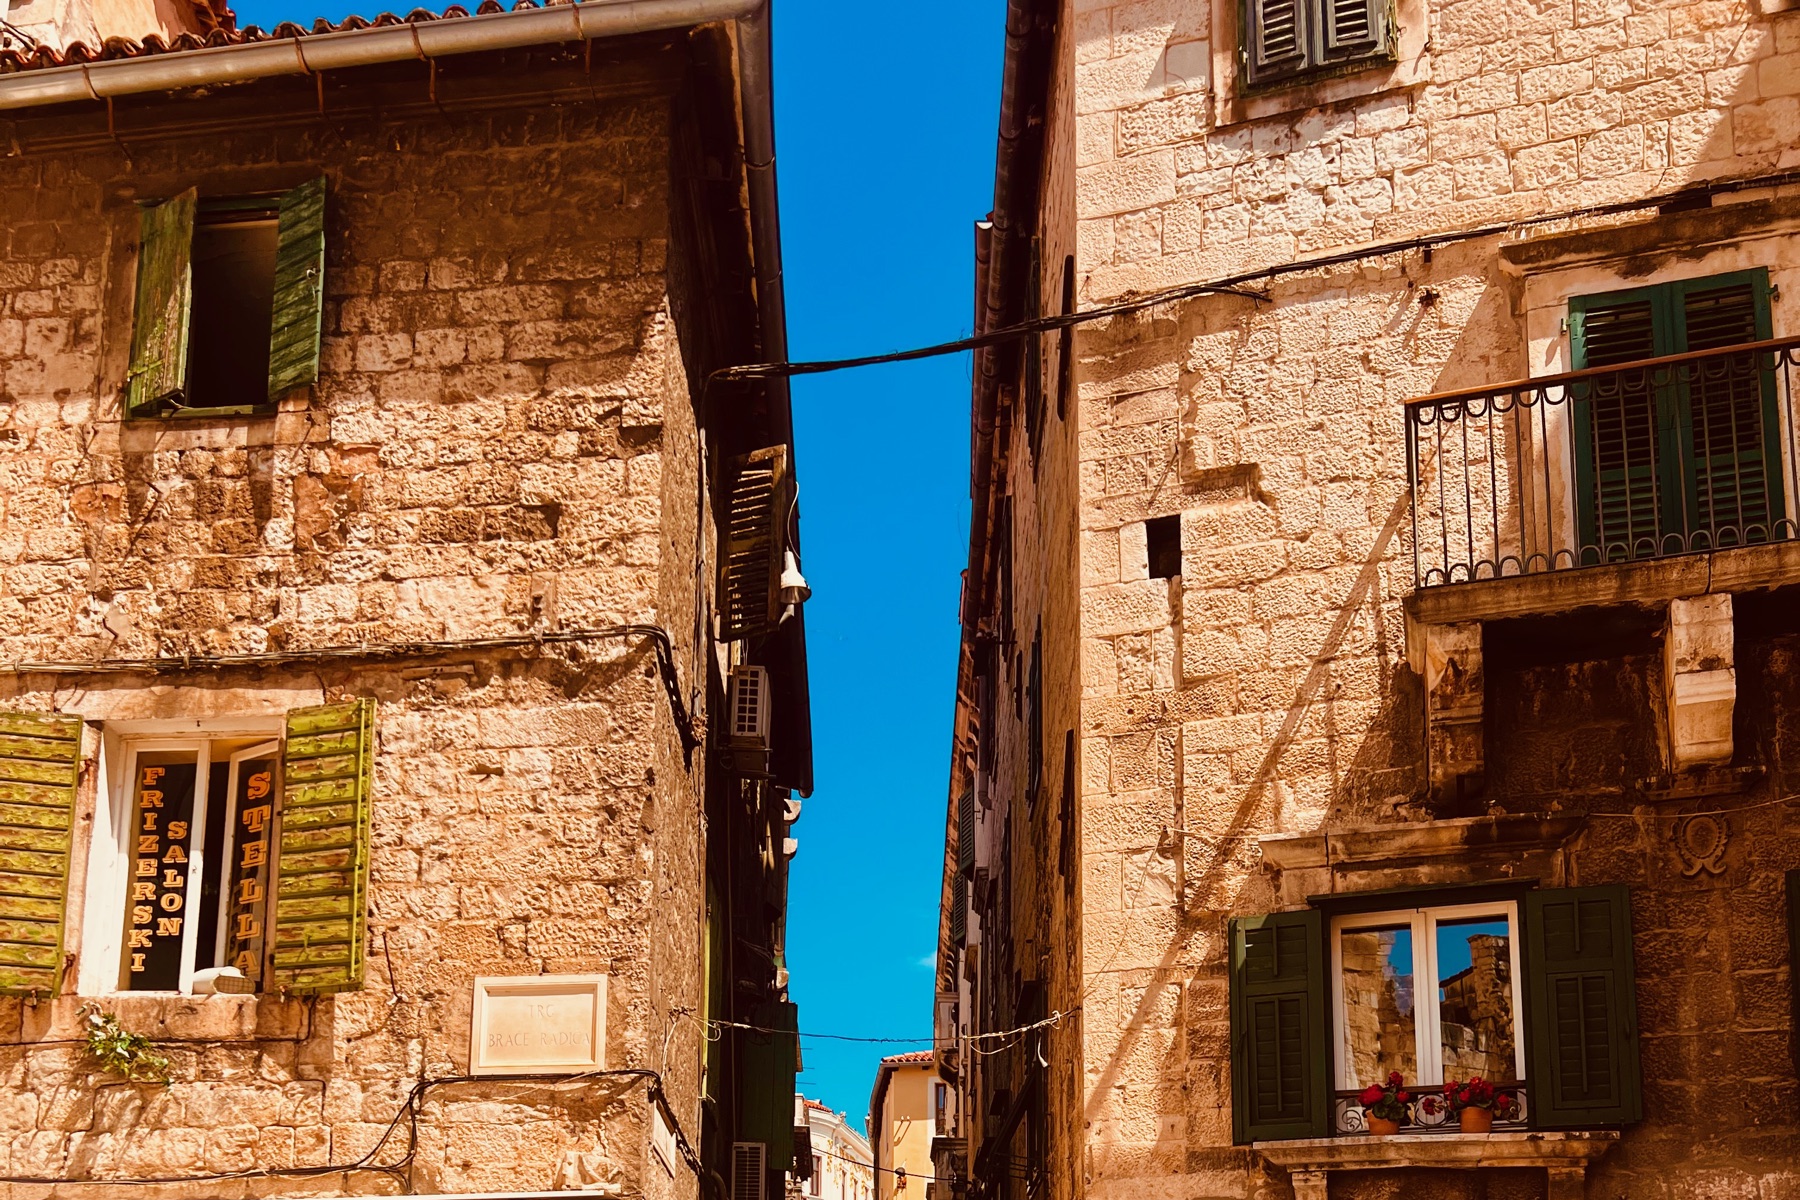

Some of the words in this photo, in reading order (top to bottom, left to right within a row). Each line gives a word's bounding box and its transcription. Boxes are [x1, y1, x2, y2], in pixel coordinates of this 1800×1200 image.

[128, 767, 165, 972] FRIZERSKI
[157, 821, 188, 936] SALON
[234, 771, 272, 976] STELLA
